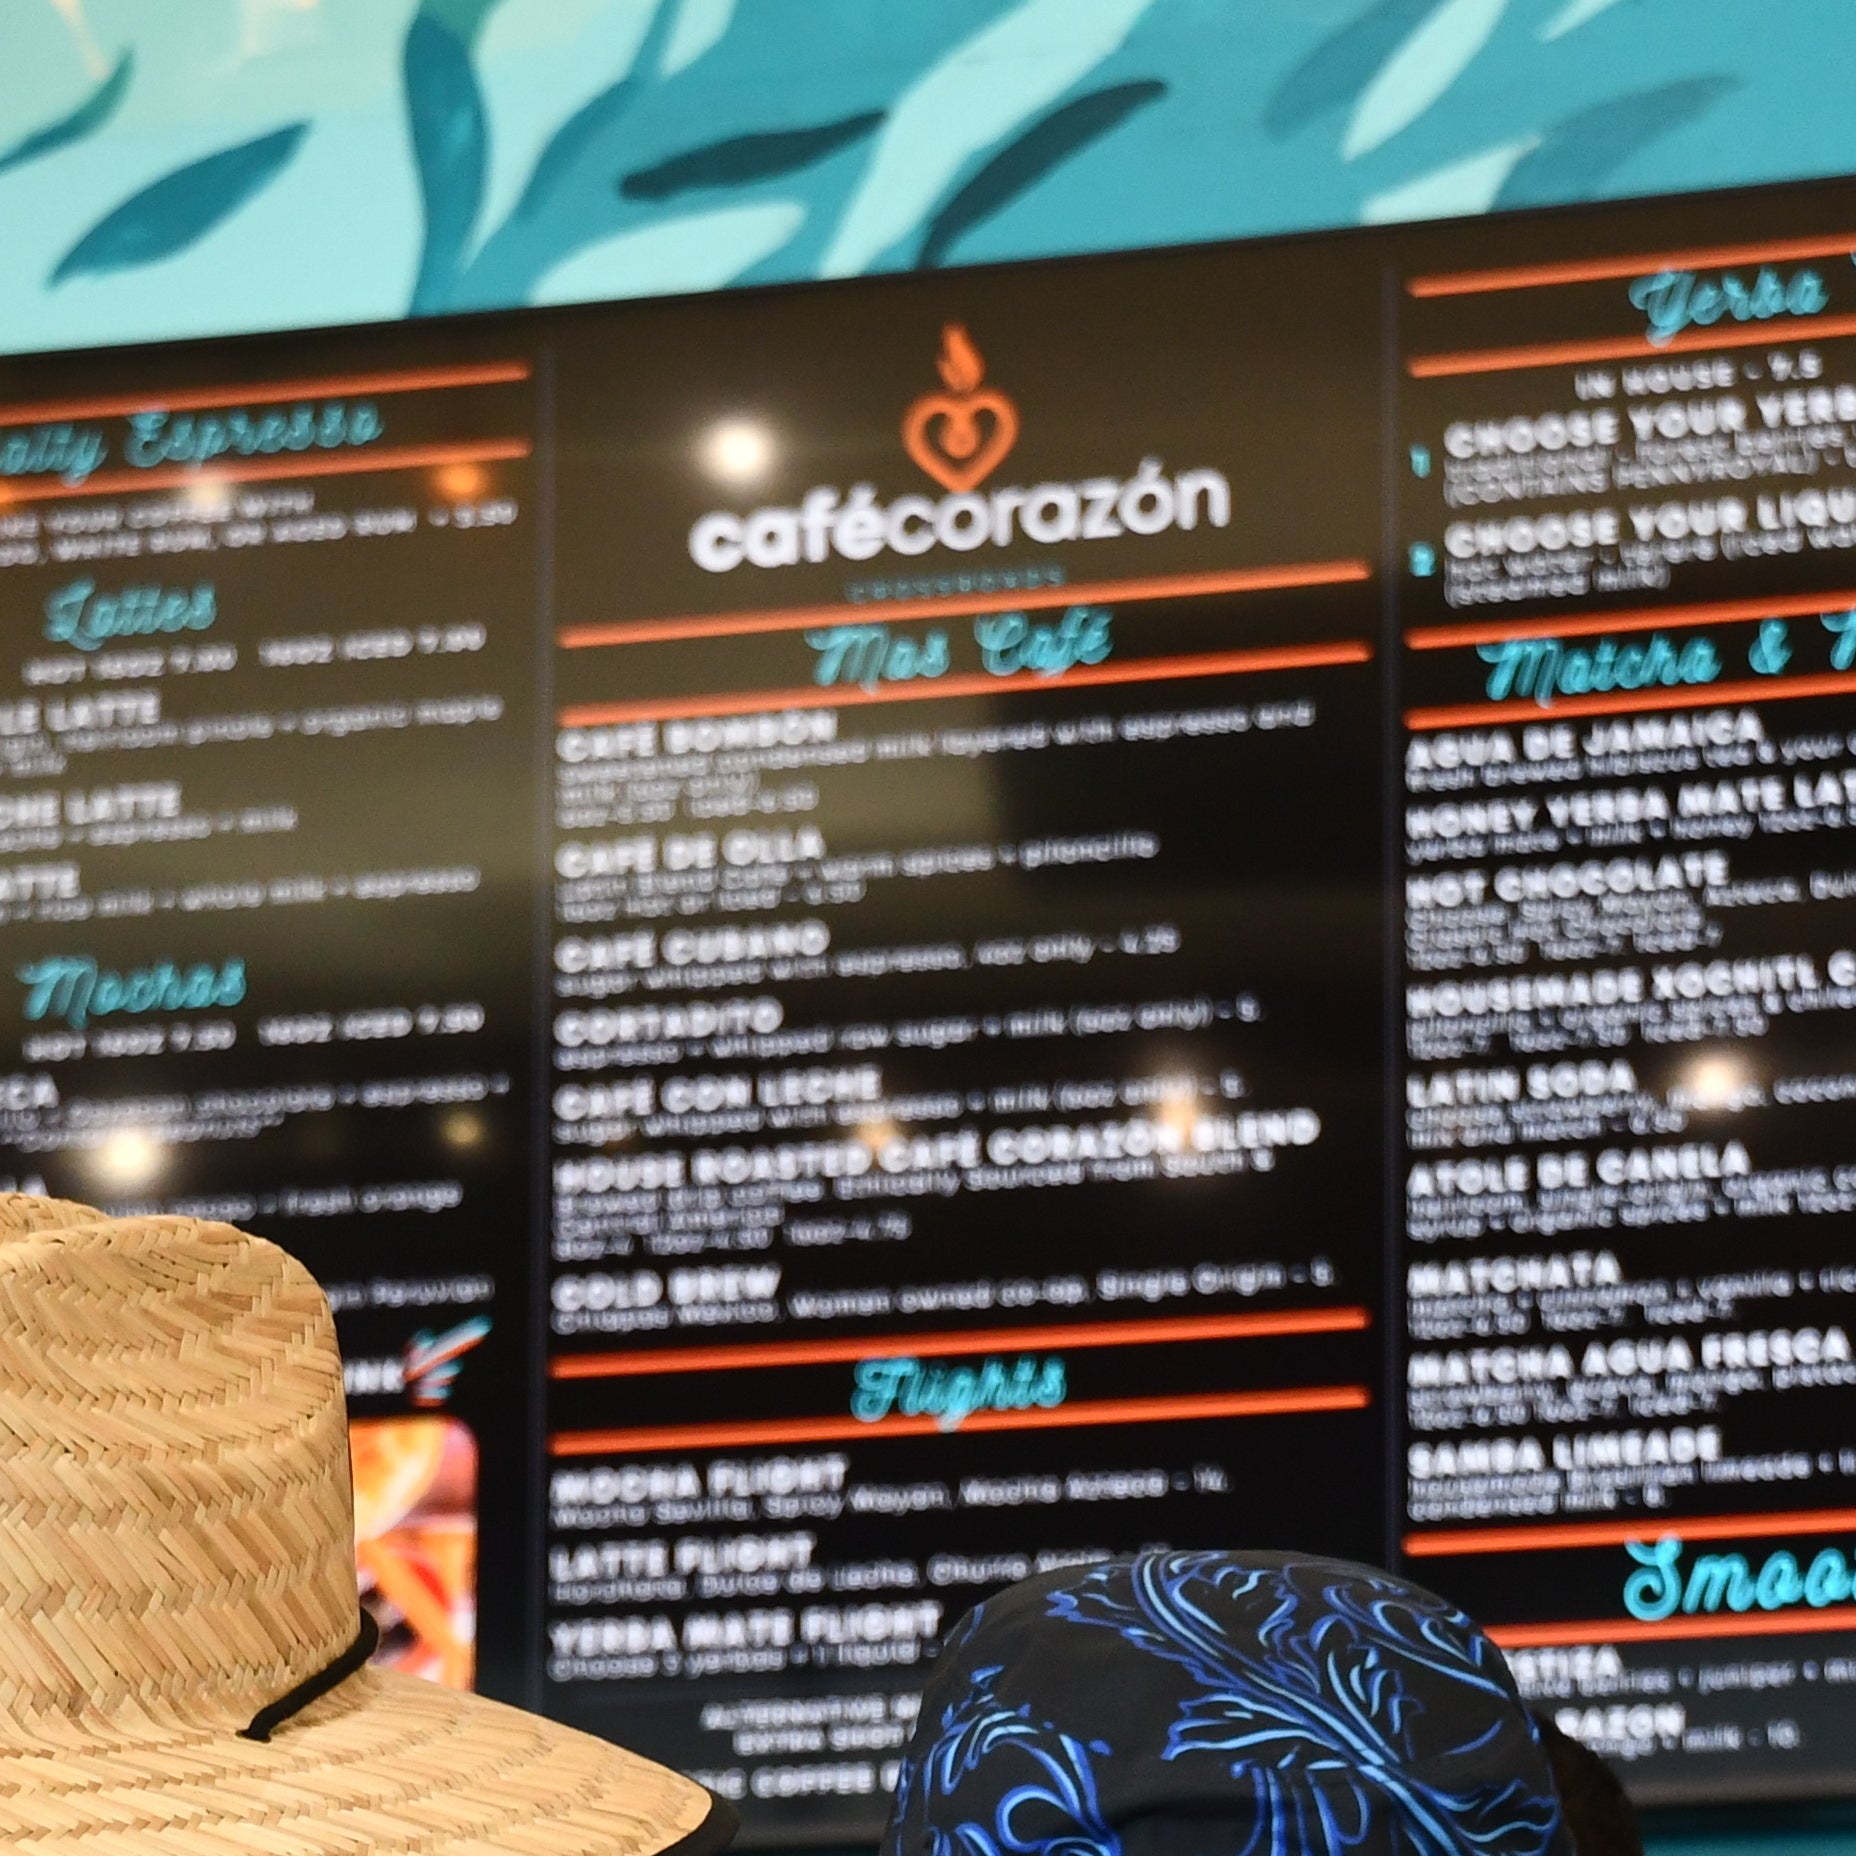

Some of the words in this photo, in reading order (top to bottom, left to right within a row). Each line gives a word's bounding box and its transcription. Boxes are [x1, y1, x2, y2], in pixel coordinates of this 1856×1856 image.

[1629, 268, 1829, 347] Yerba
[687, 457, 1231, 574] cafécorazón
[1476, 632, 1721, 708] Matcha
[1749, 620, 1790, 674] &
[16, 953, 248, 1029] Mochas
[851, 1356, 1067, 1430] Flights
